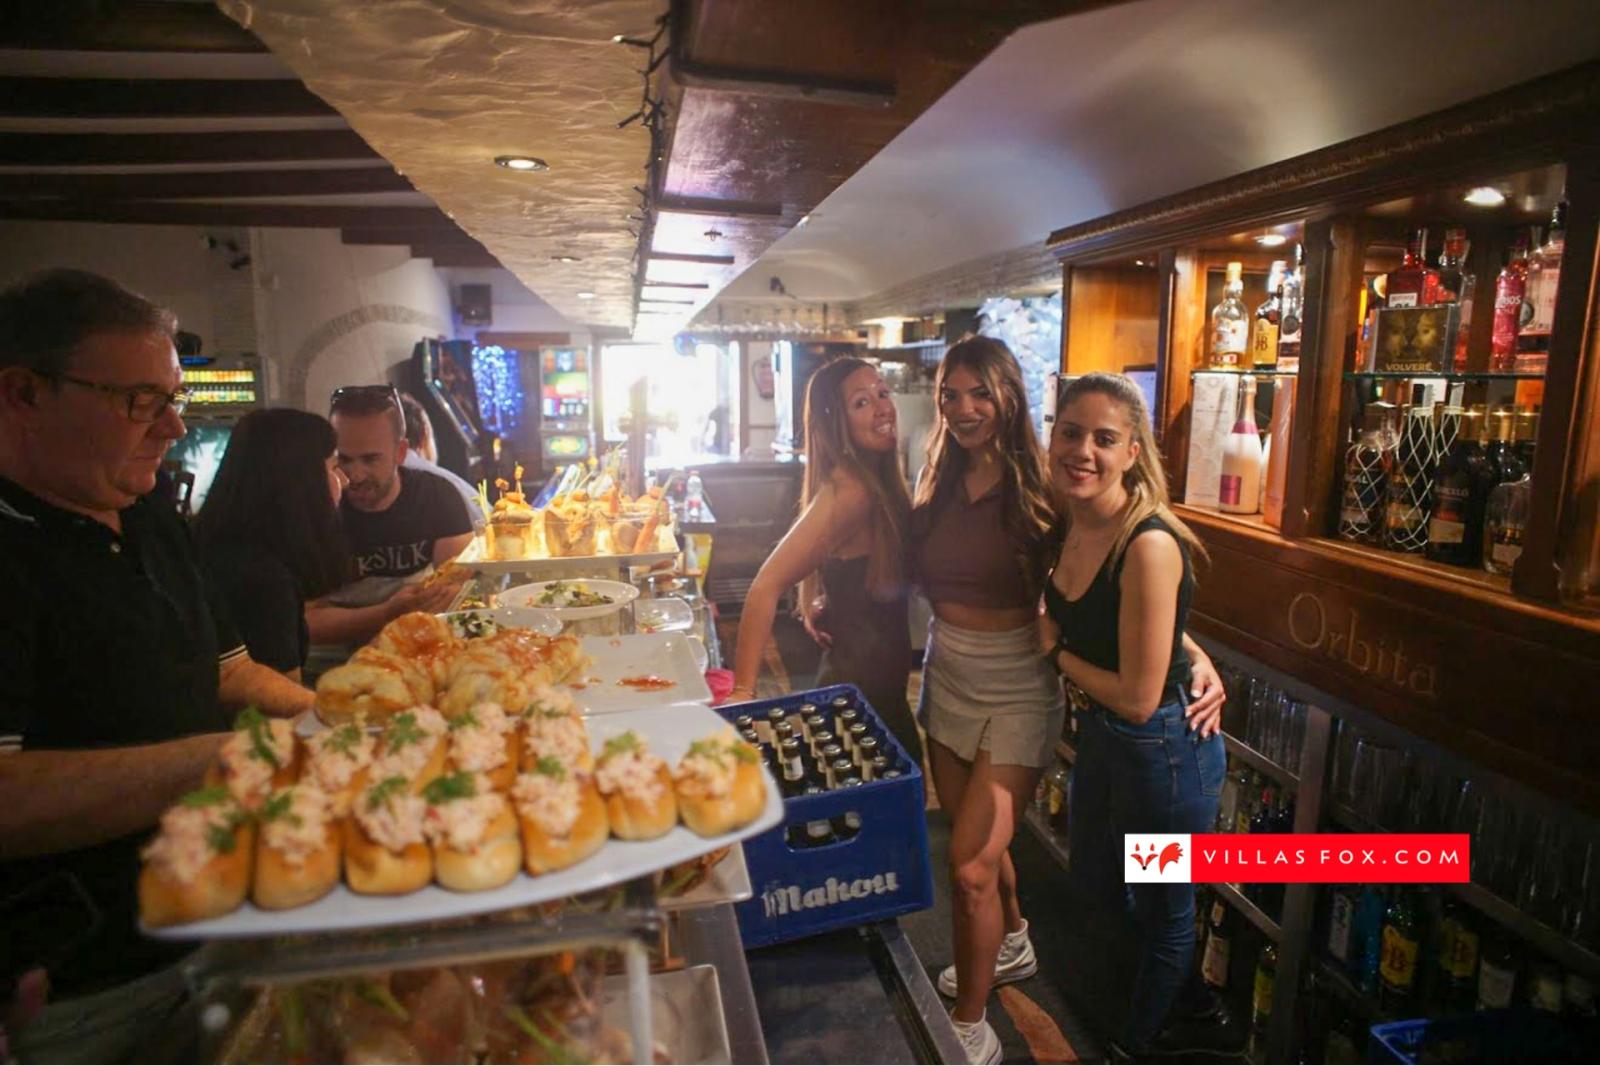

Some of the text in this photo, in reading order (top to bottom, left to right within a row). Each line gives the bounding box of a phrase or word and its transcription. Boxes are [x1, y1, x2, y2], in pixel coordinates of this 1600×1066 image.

[1385, 362, 1433, 372] VOLVERÉ
[357, 540, 428, 577] KSILK
[1288, 592, 1438, 698] Orbita
[761, 872, 899, 918] Mahou
